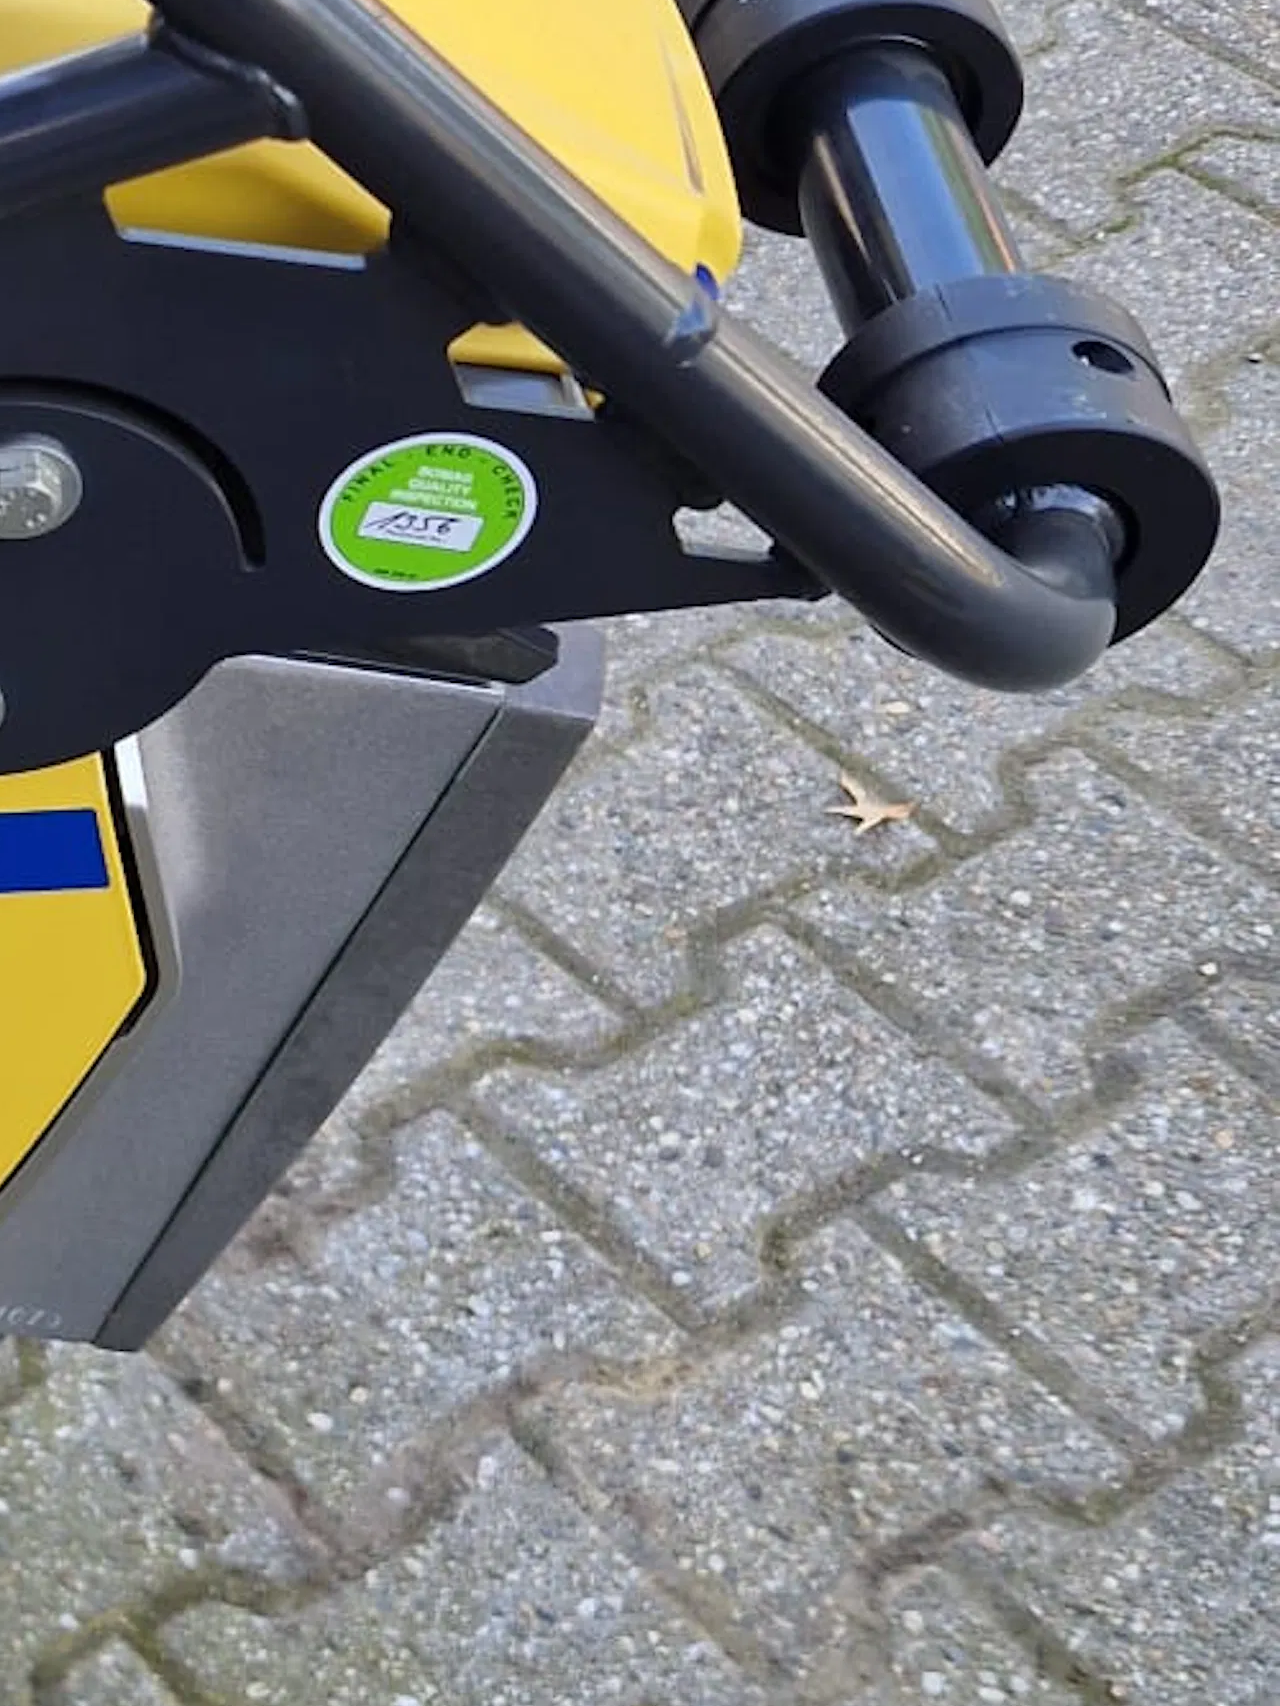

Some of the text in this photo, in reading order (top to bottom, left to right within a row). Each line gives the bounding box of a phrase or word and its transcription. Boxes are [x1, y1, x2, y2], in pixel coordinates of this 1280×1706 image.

[342, 444, 522, 518] FINAL END CHECK
[408, 478, 471, 495] QUALITY
